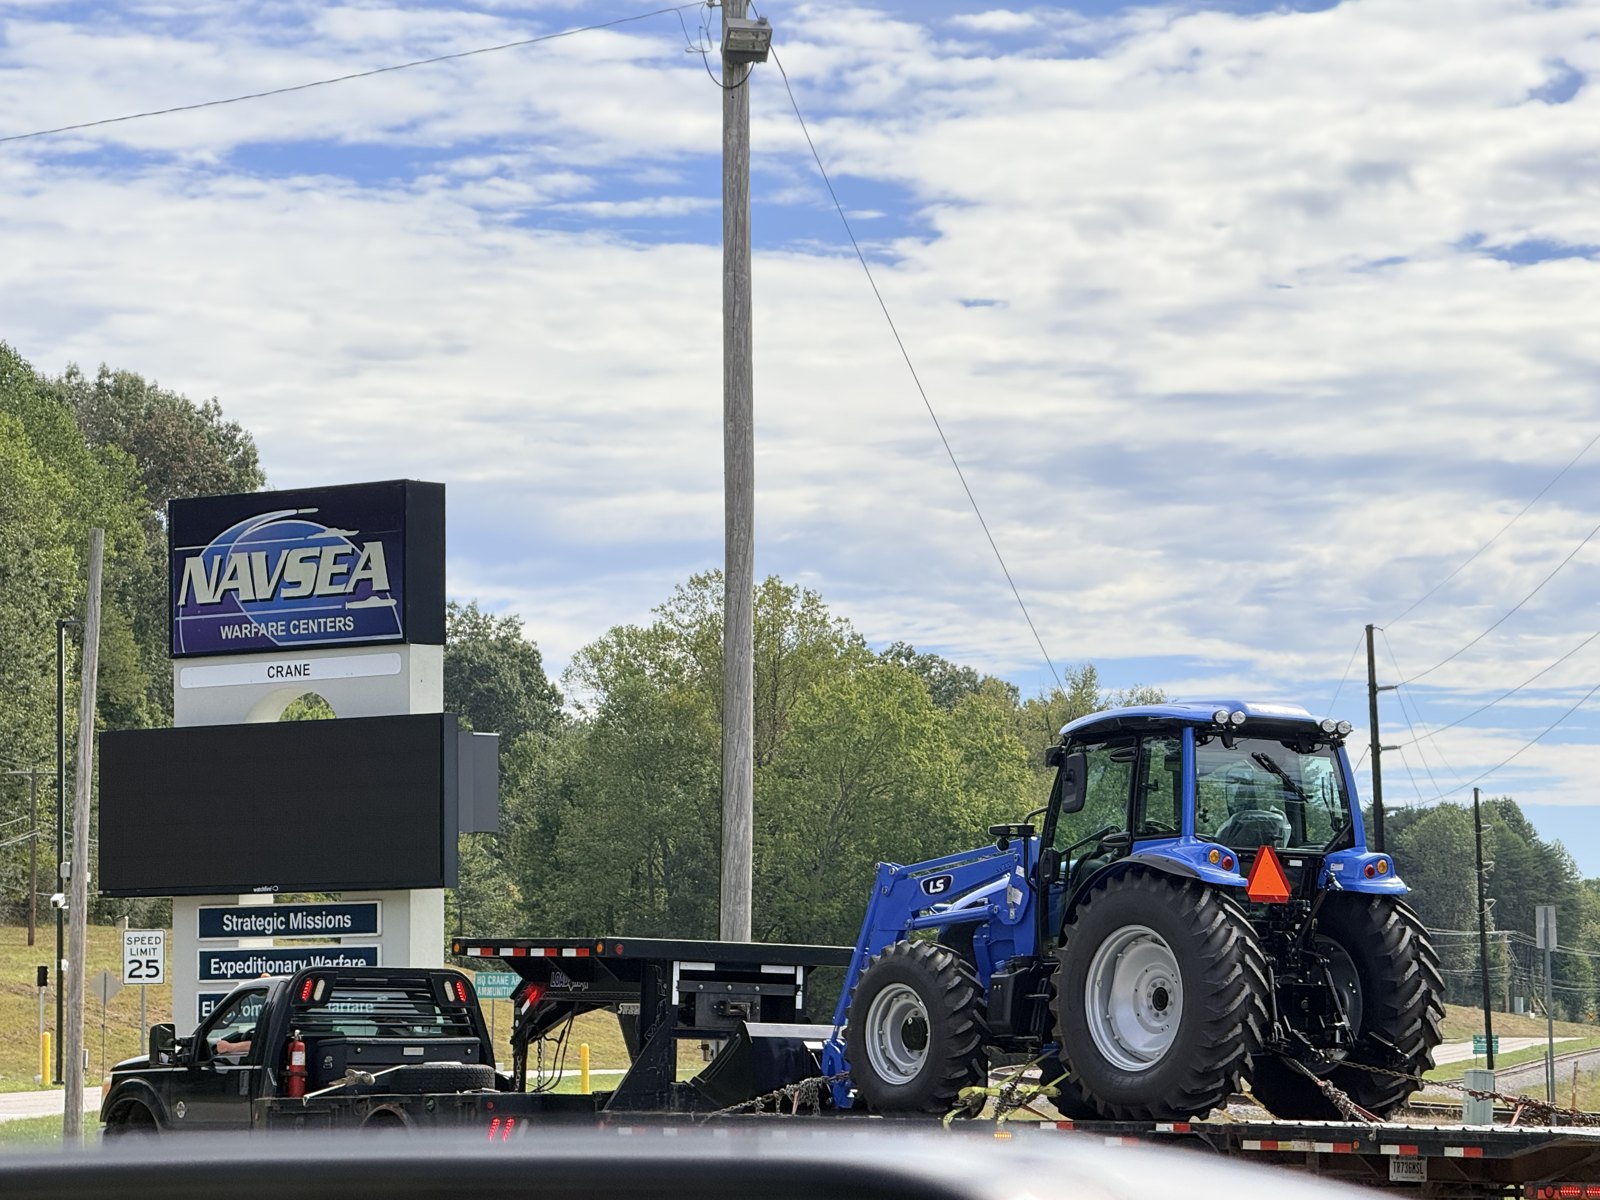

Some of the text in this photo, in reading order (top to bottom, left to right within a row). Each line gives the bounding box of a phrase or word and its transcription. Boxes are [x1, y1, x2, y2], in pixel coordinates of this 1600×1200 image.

[177, 541, 390, 606] NAVSEA
[220, 617, 354, 640] WARFARE CENTERS
[267, 663, 311, 679] CRANE
[929, 879, 945, 893] LS
[222, 911, 352, 934] Strategic Missions
[126, 936, 162, 945] SPEED
[130, 948, 157, 956] LIMIT
[128, 959, 160, 979] 25
[210, 956, 307, 978] Expeditionary
[487, 976, 510, 985] CRANE
